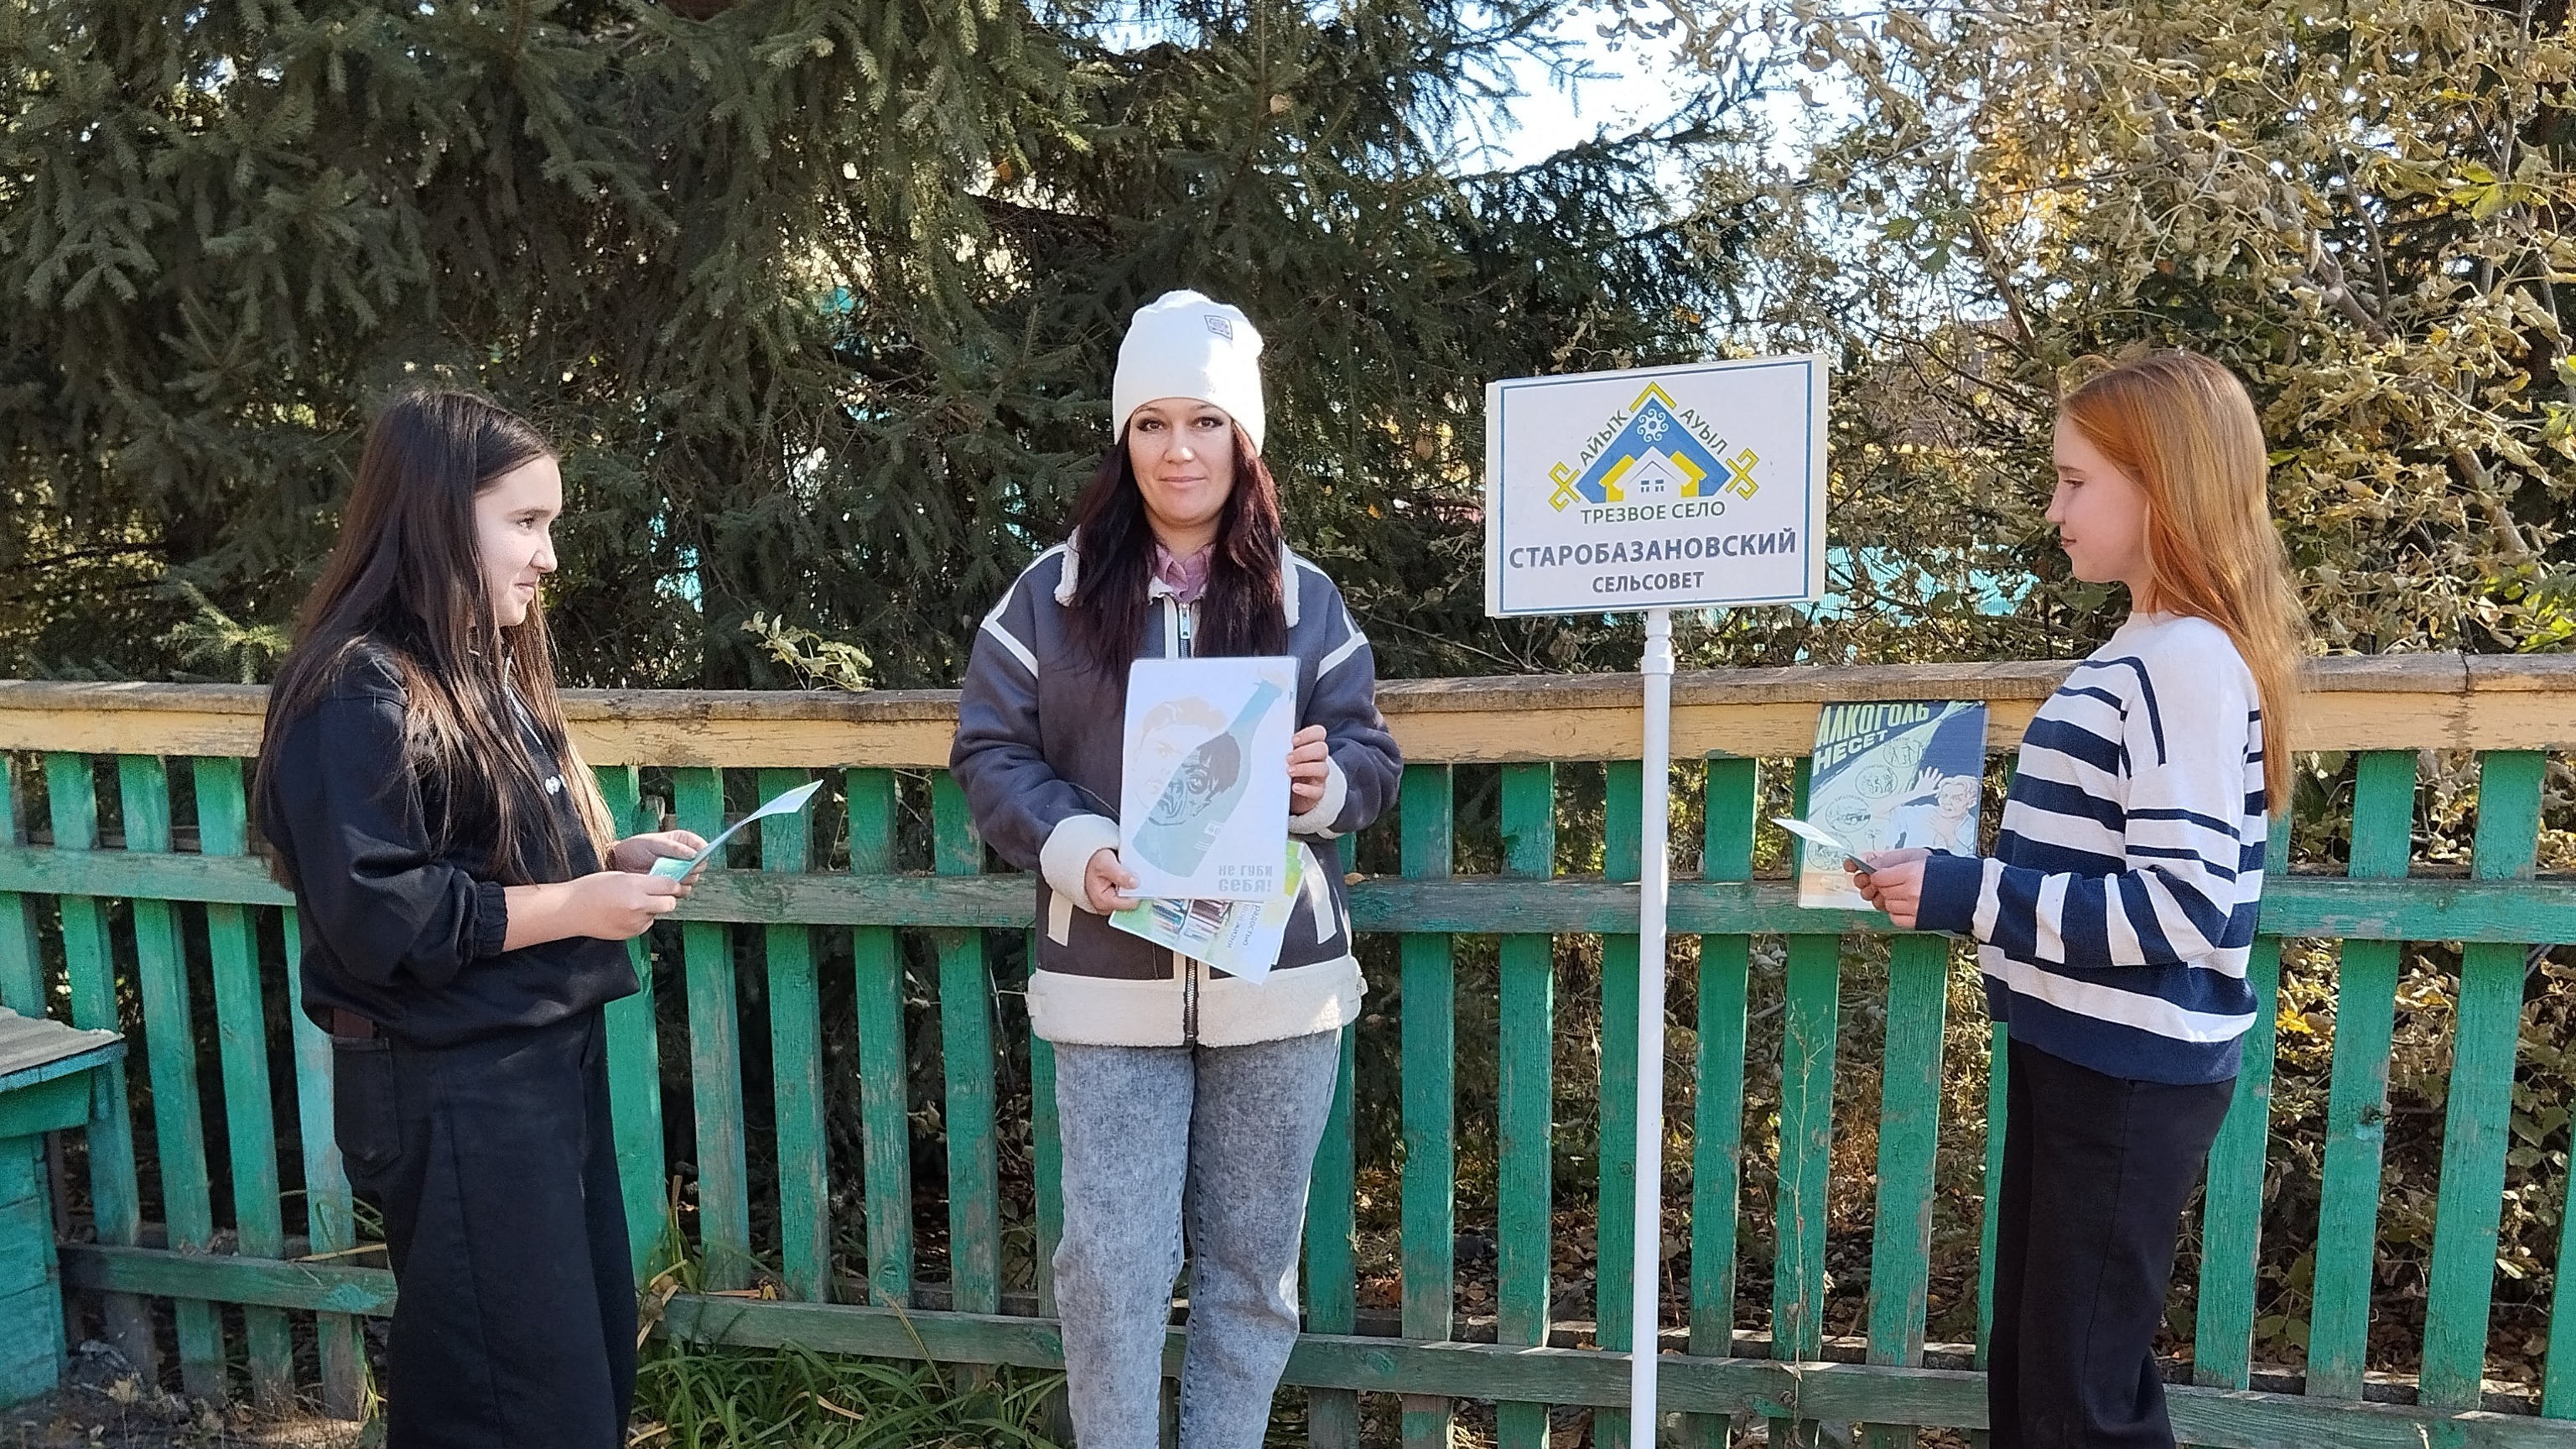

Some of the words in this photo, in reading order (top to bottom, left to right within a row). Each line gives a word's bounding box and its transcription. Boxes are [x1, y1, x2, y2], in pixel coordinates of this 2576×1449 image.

[1679, 408, 1728, 455] АУЫЛ
[1581, 503, 1666, 524] ТРЕЗВОЕ
[1671, 501, 1726, 519] СЕЛО
[1509, 527, 1796, 569] СТАРОБАЗАНОВСКИЙ
[1592, 571, 1704, 593] СЕЛЬСОВЕТ
[1815, 703, 1929, 749] АЛКОГОЛЬ
[1812, 730, 1888, 777] НЕСЕТ
[1241, 865, 1273, 877] ГУБИ
